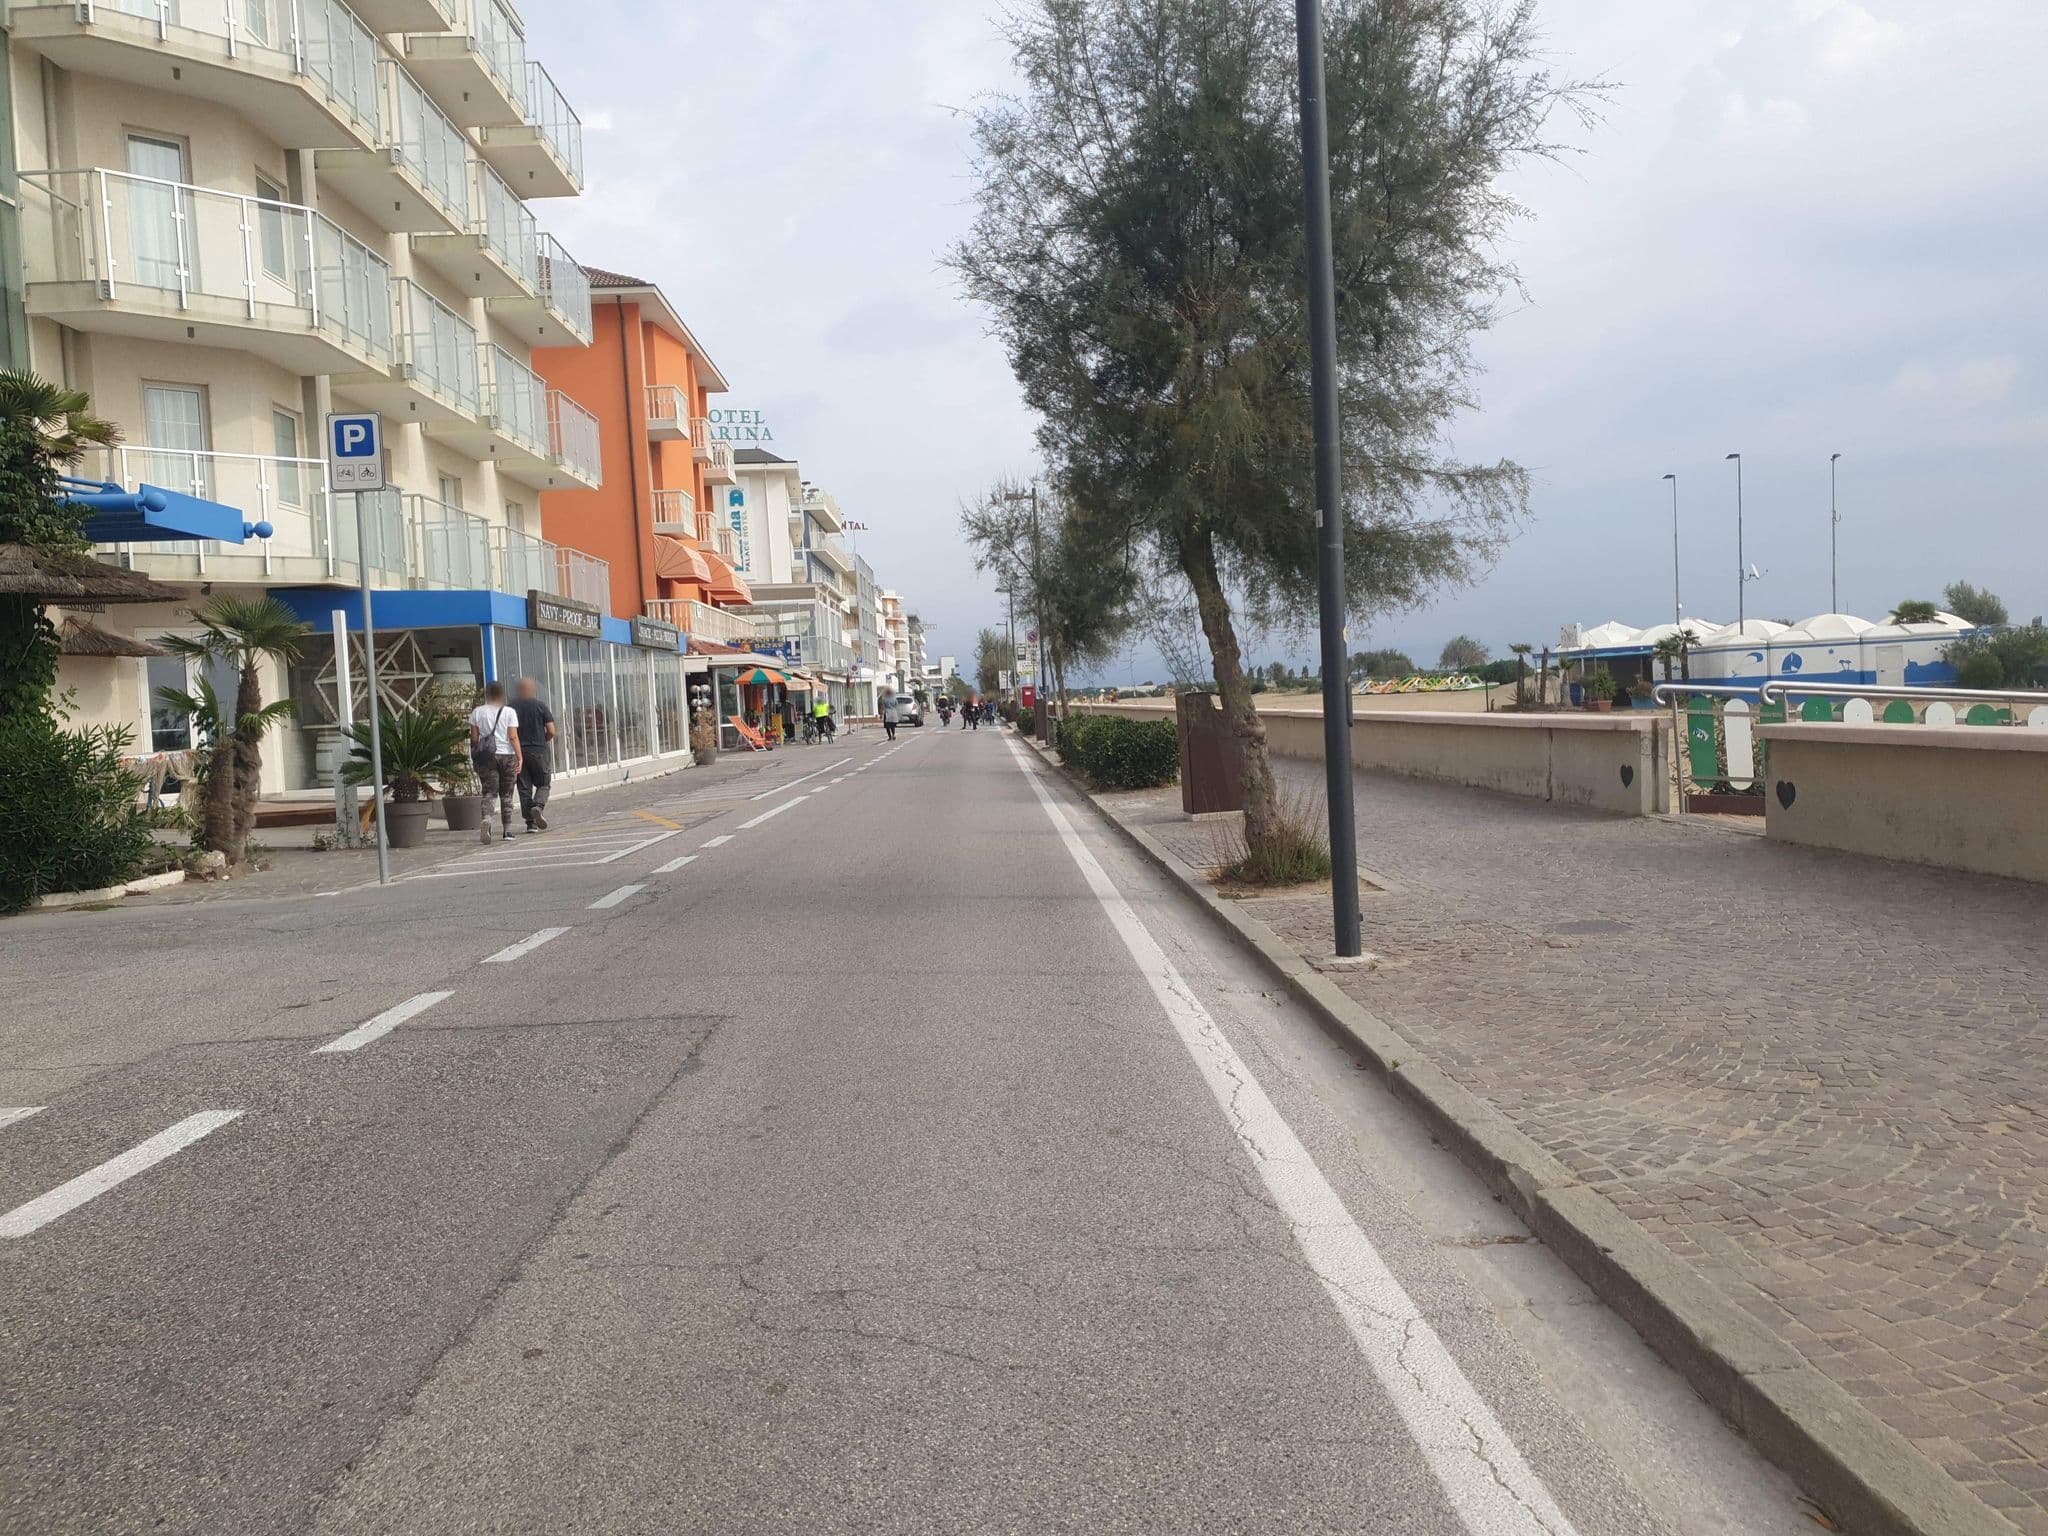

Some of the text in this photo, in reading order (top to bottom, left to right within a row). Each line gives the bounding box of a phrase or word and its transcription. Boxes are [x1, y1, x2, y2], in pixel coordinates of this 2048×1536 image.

[343, 424, 366, 453] P
[540, 603, 559, 621] NAVY
[562, 608, 583, 626] PROOF
